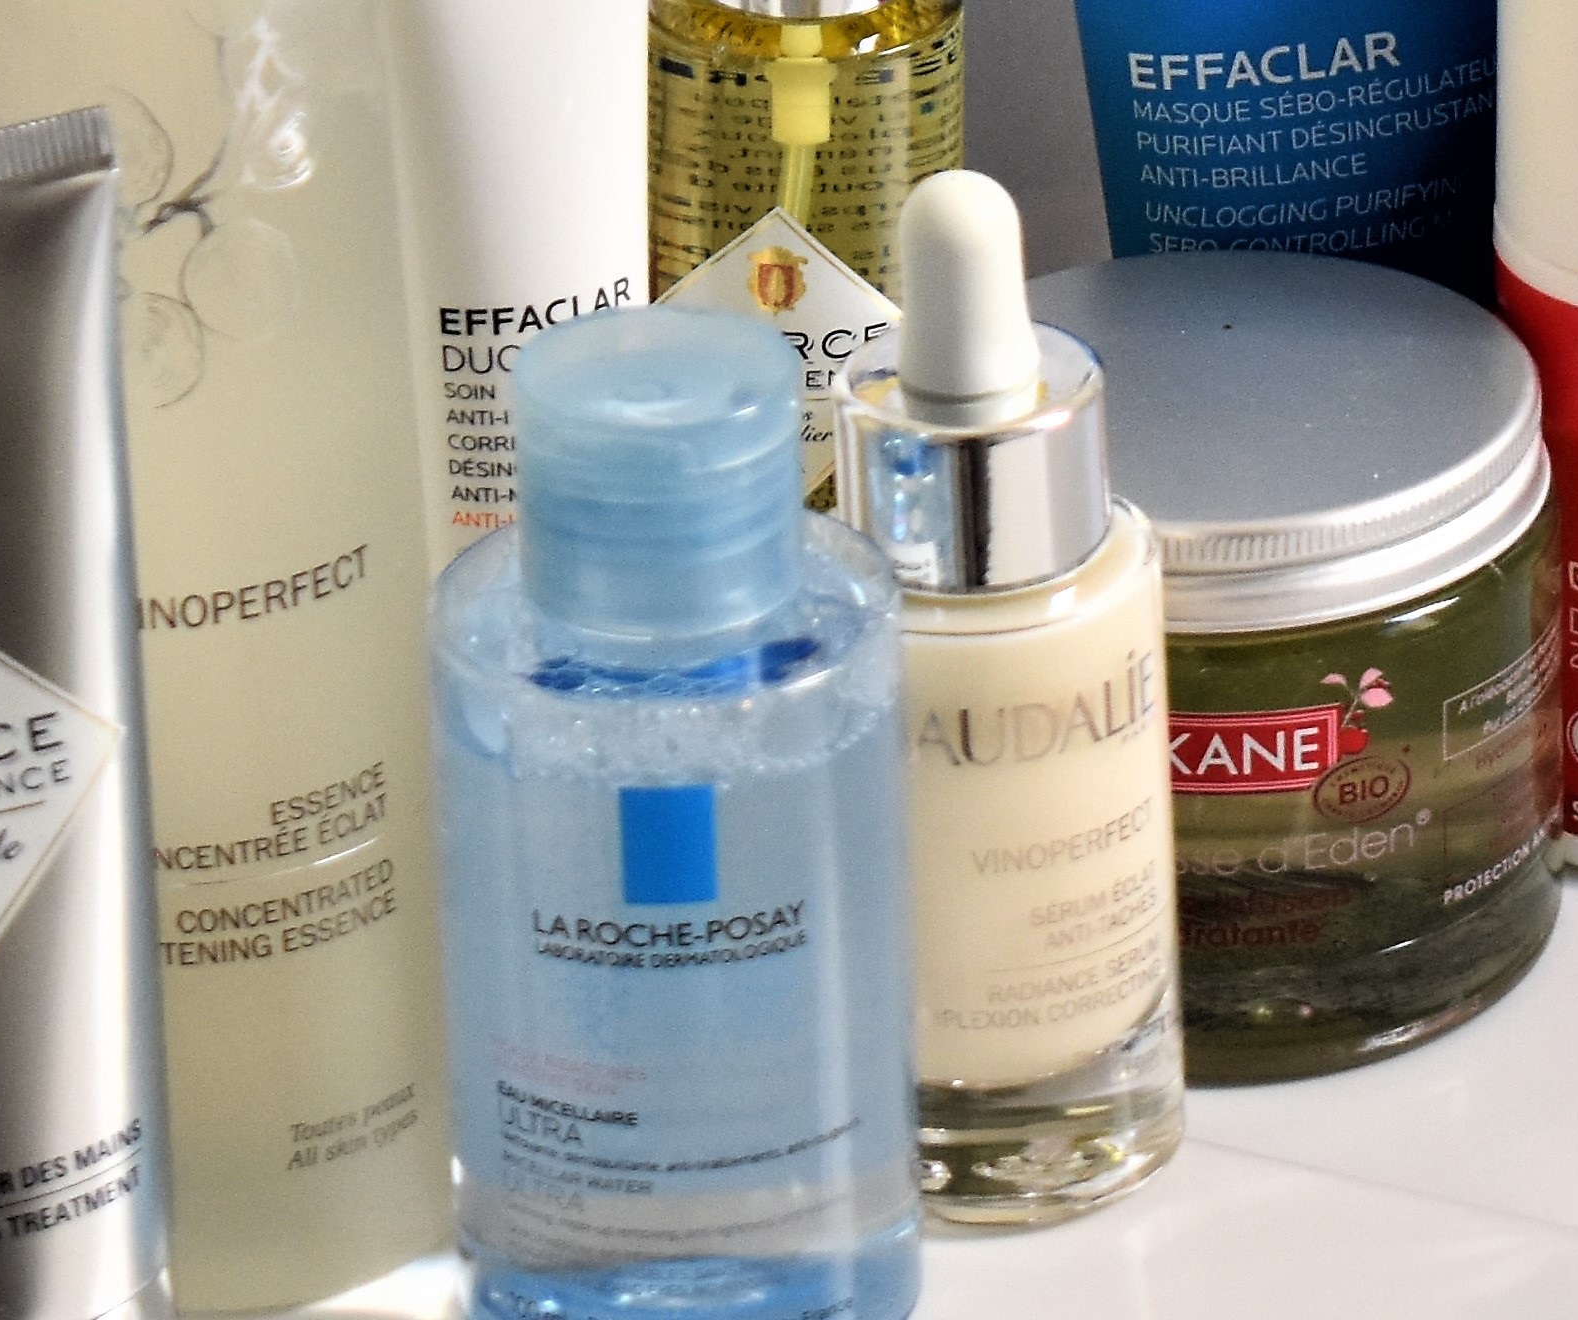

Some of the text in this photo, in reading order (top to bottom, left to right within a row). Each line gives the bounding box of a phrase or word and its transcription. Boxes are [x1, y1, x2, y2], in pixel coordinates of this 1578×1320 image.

[1128, 31, 1401, 91] EFFACLAR
[1133, 99, 1252, 129] MASQUE
[1136, 130, 1283, 157] PURIFIANT
[1140, 152, 1368, 190] ANTI-BRILLANCE
[1145, 195, 1328, 228] UNCLOGGING
[444, 381, 497, 401] SOIN
[448, 457, 518, 479] DÉSIN
[137, 543, 369, 630] INOPERFECT
[1168, 726, 1320, 776] KANE
[270, 760, 386, 827] ESSENCE
[1338, 773, 1390, 805] BIO
[152, 792, 388, 871] NCENTRÉE ÉCLAT
[972, 797, 1153, 875] VINOPERFECT
[176, 858, 395, 935] CONCENTRATED
[531, 899, 806, 947] LA ROCHE-POSAY
[159, 888, 398, 966] TENING ESSENCE
[20, 1156, 68, 1189] DES
[73, 1117, 143, 1171] MAINS
[6, 1164, 142, 1237] TREATMENT
